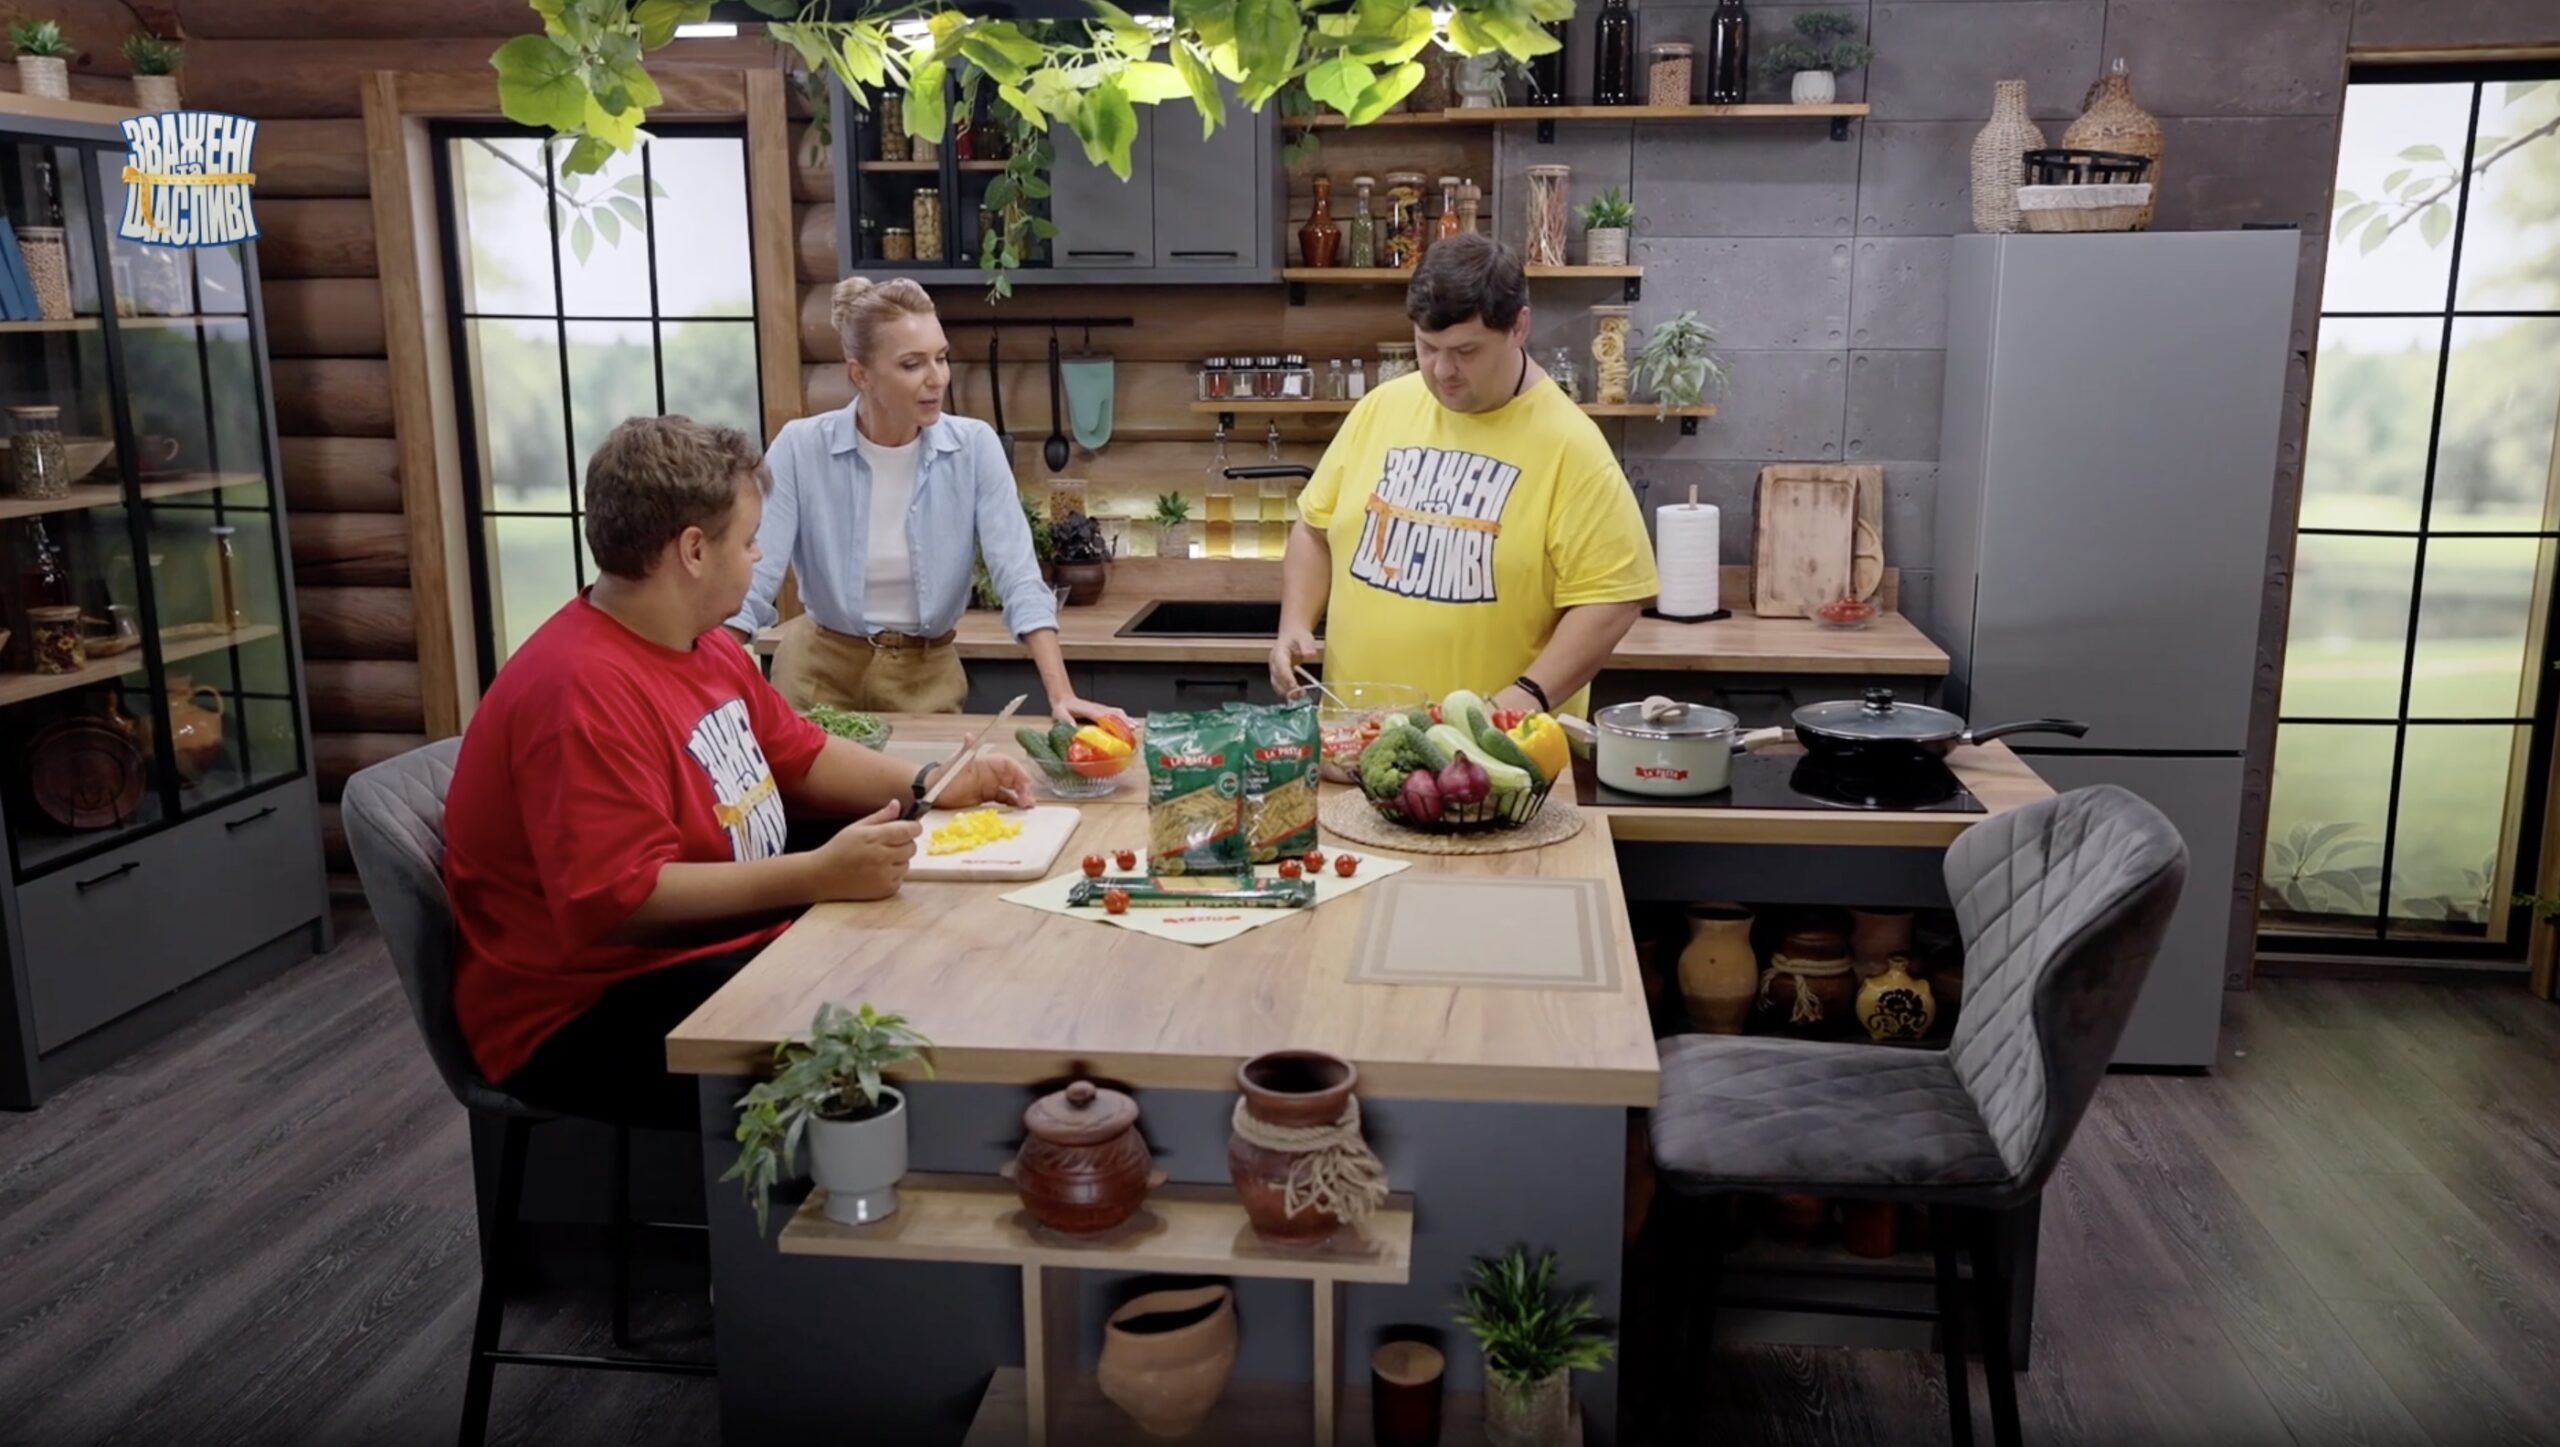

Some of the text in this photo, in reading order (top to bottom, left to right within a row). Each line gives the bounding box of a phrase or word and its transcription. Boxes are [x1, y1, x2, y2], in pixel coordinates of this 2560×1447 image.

[1376, 447, 1522, 522] ЗВАЖЕНІ
[1350, 513, 1497, 602] ЩАСЛИВІ
[685, 698, 771, 808] ЗВАЖЕ
